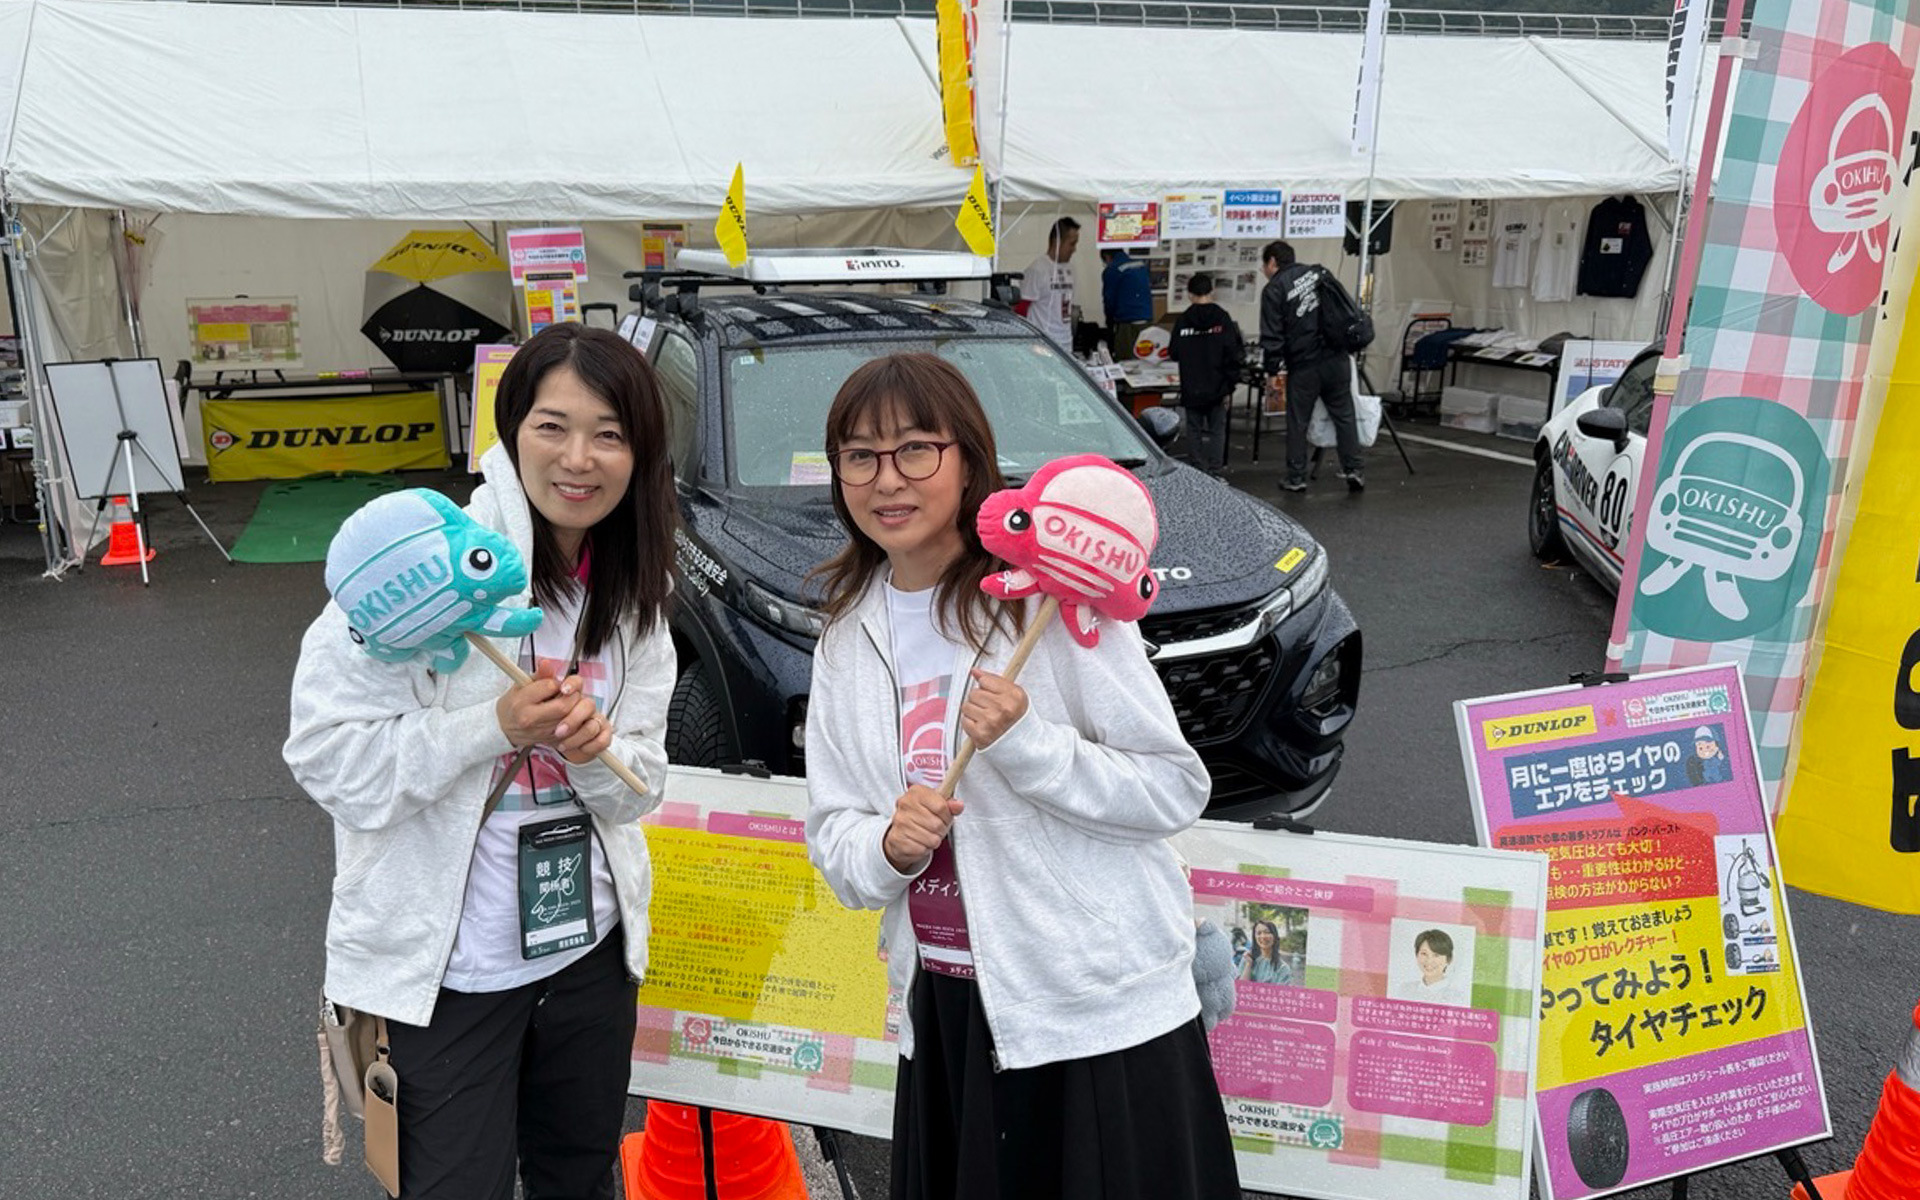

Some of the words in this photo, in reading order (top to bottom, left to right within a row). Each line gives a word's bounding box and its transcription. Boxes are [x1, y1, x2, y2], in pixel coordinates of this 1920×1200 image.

[392, 328, 480, 342] DUNLOP
[246, 422, 435, 450] DUNLOP
[1600, 470, 1628, 533] 80
[1682, 487, 1776, 530] OKISHU
[1044, 515, 1141, 575] OKISHU
[350, 554, 449, 631] OKISHU
[1508, 715, 1587, 738] DUNLOP
[1510, 741, 1681, 790] 月に一度はタイヤの
[1535, 768, 1667, 811] エアをチェック
[1590, 985, 1767, 1057] タイヤチェック
[713, 1035, 793, 1056] 今日からできる交通安全
[1238, 1103, 1280, 1117] OKISHU
